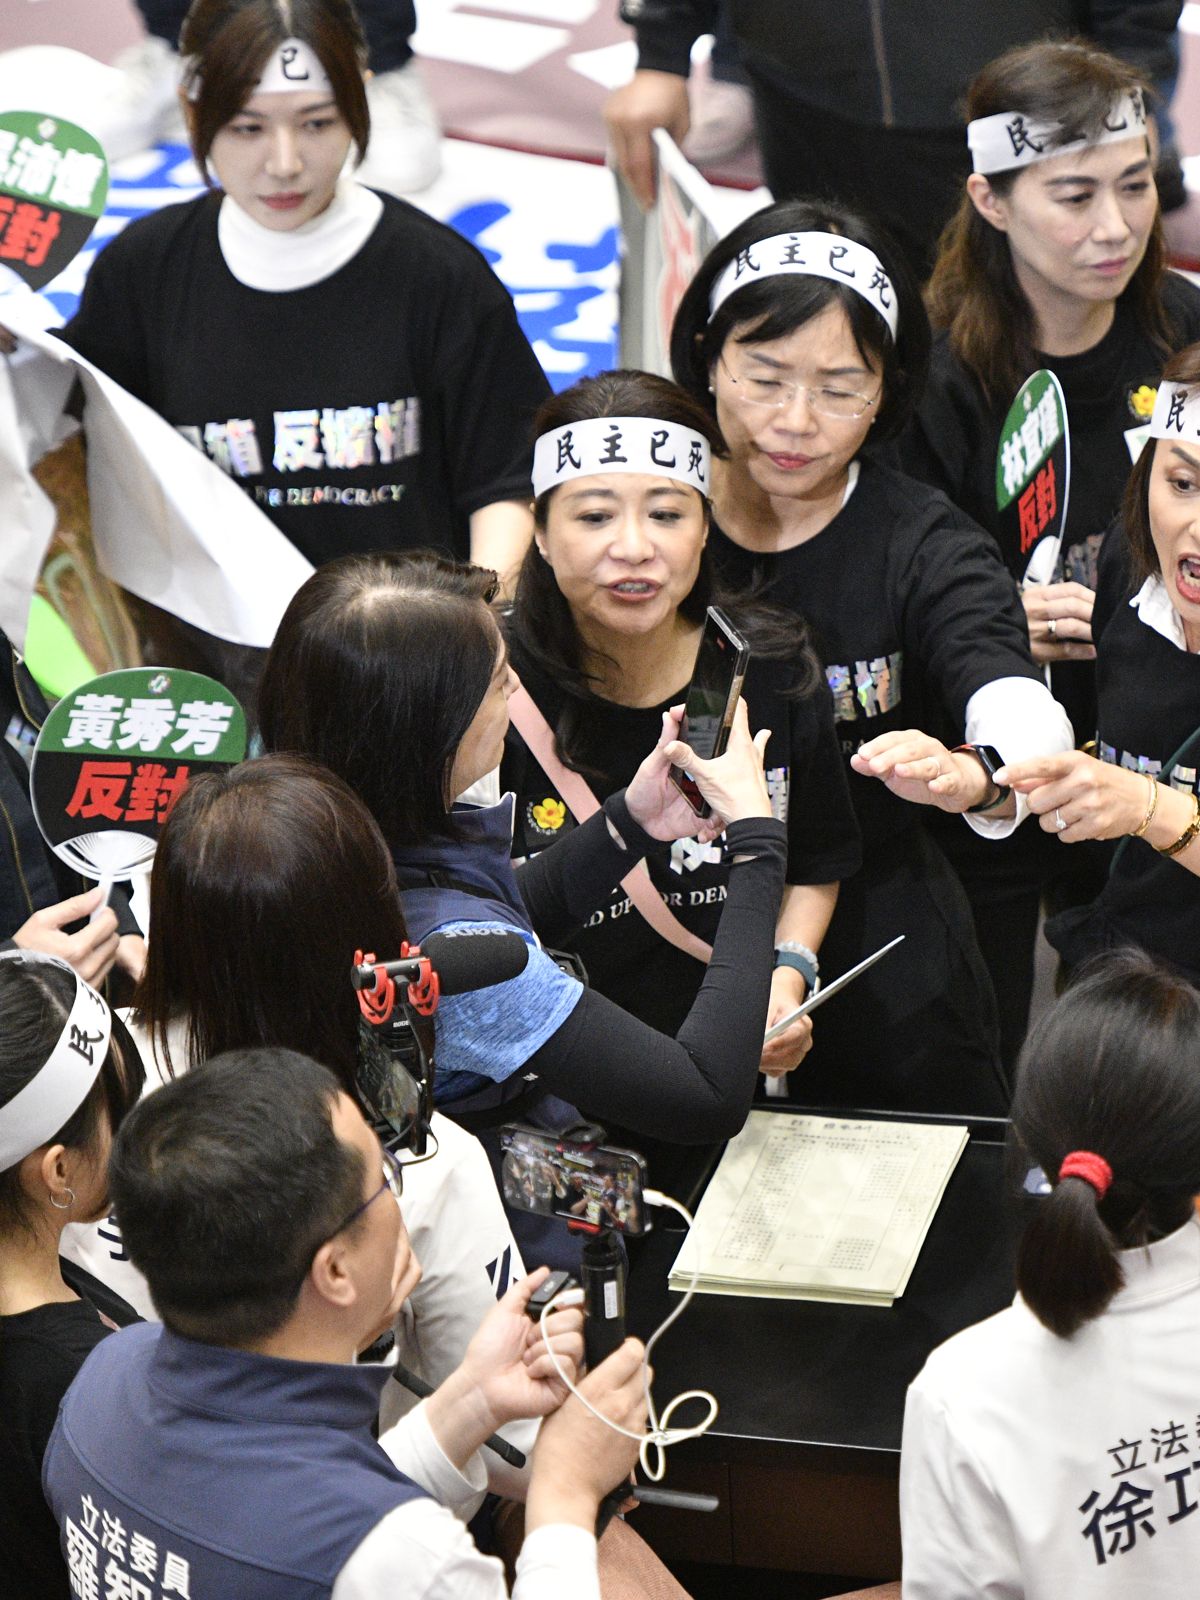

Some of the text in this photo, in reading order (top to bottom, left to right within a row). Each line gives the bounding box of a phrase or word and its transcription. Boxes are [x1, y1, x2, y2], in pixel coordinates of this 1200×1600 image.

[735, 235, 891, 309] 民主已死
[556, 425, 704, 482] 民主已死
[1018, 458, 1057, 553] 反對
[62, 694, 234, 755] 黃秀芳
[65, 761, 190, 824] 反對
[80, 1494, 191, 1600] 立法委員
